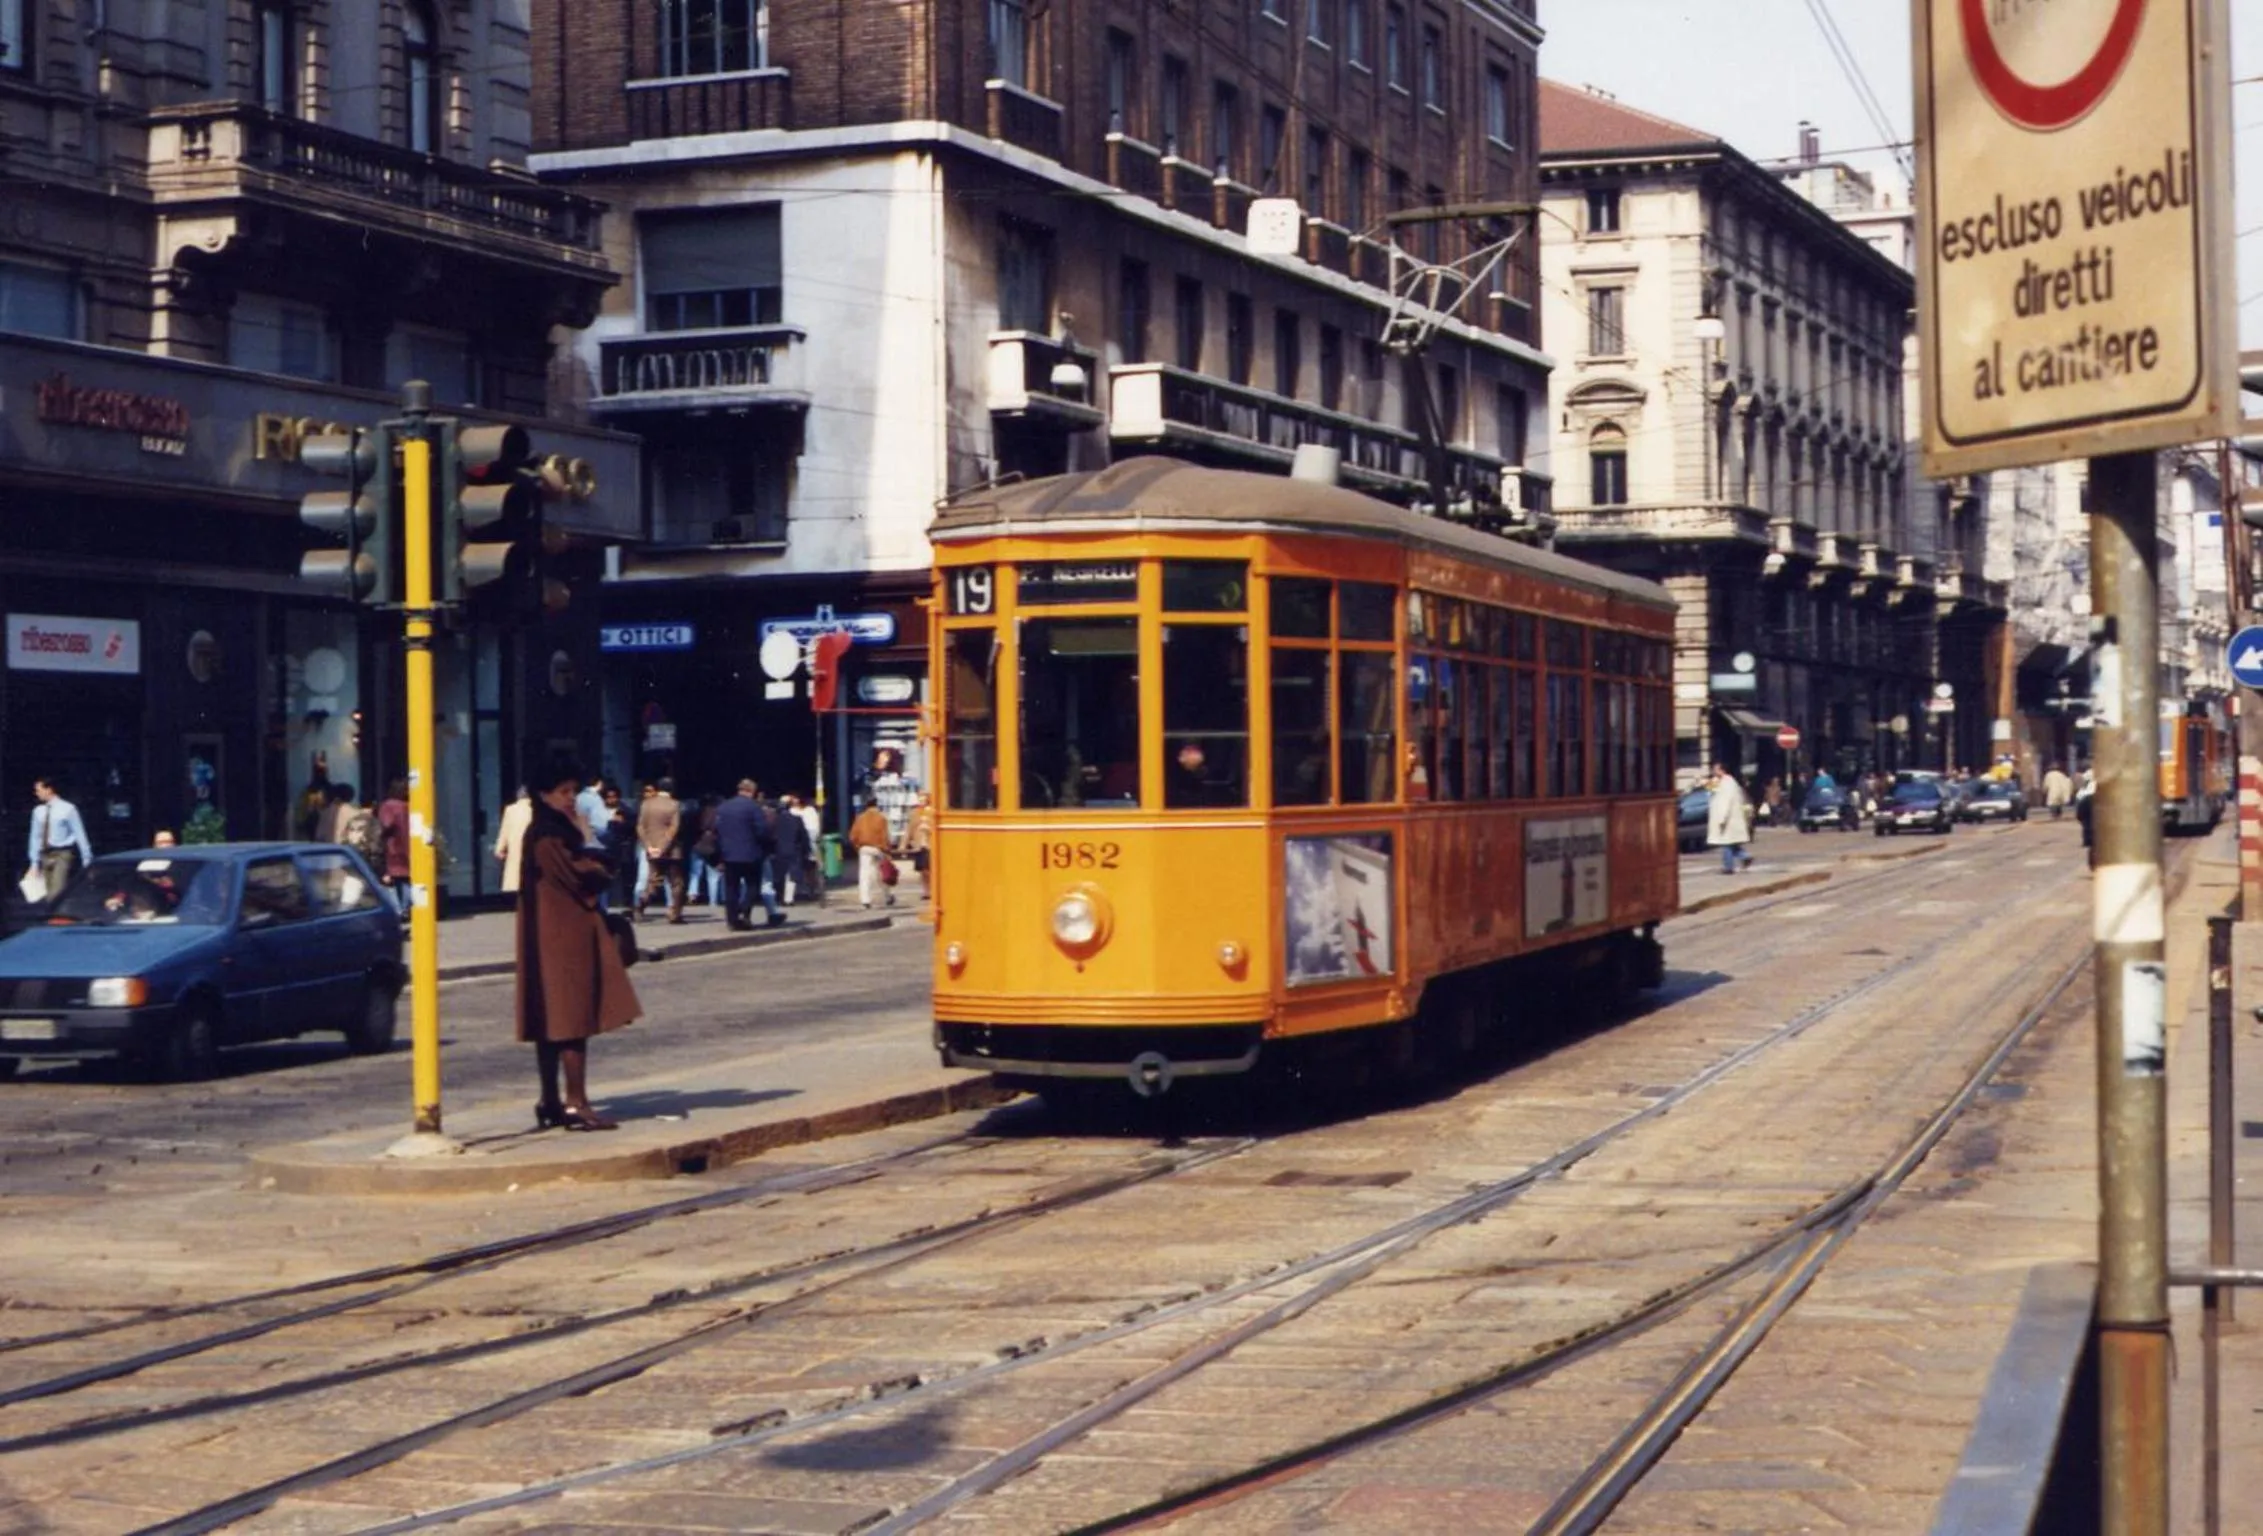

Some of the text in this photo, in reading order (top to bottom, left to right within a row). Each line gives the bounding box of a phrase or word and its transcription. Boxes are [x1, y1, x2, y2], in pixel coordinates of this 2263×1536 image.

[1941, 148, 2190, 263] escluso veicoli
[2014, 248, 2114, 318] diretti
[1974, 326, 2158, 400] al cantiere
[957, 567, 992, 614] 19
[619, 628, 681, 644] OTTICI
[1042, 843, 1120, 869] 1982
